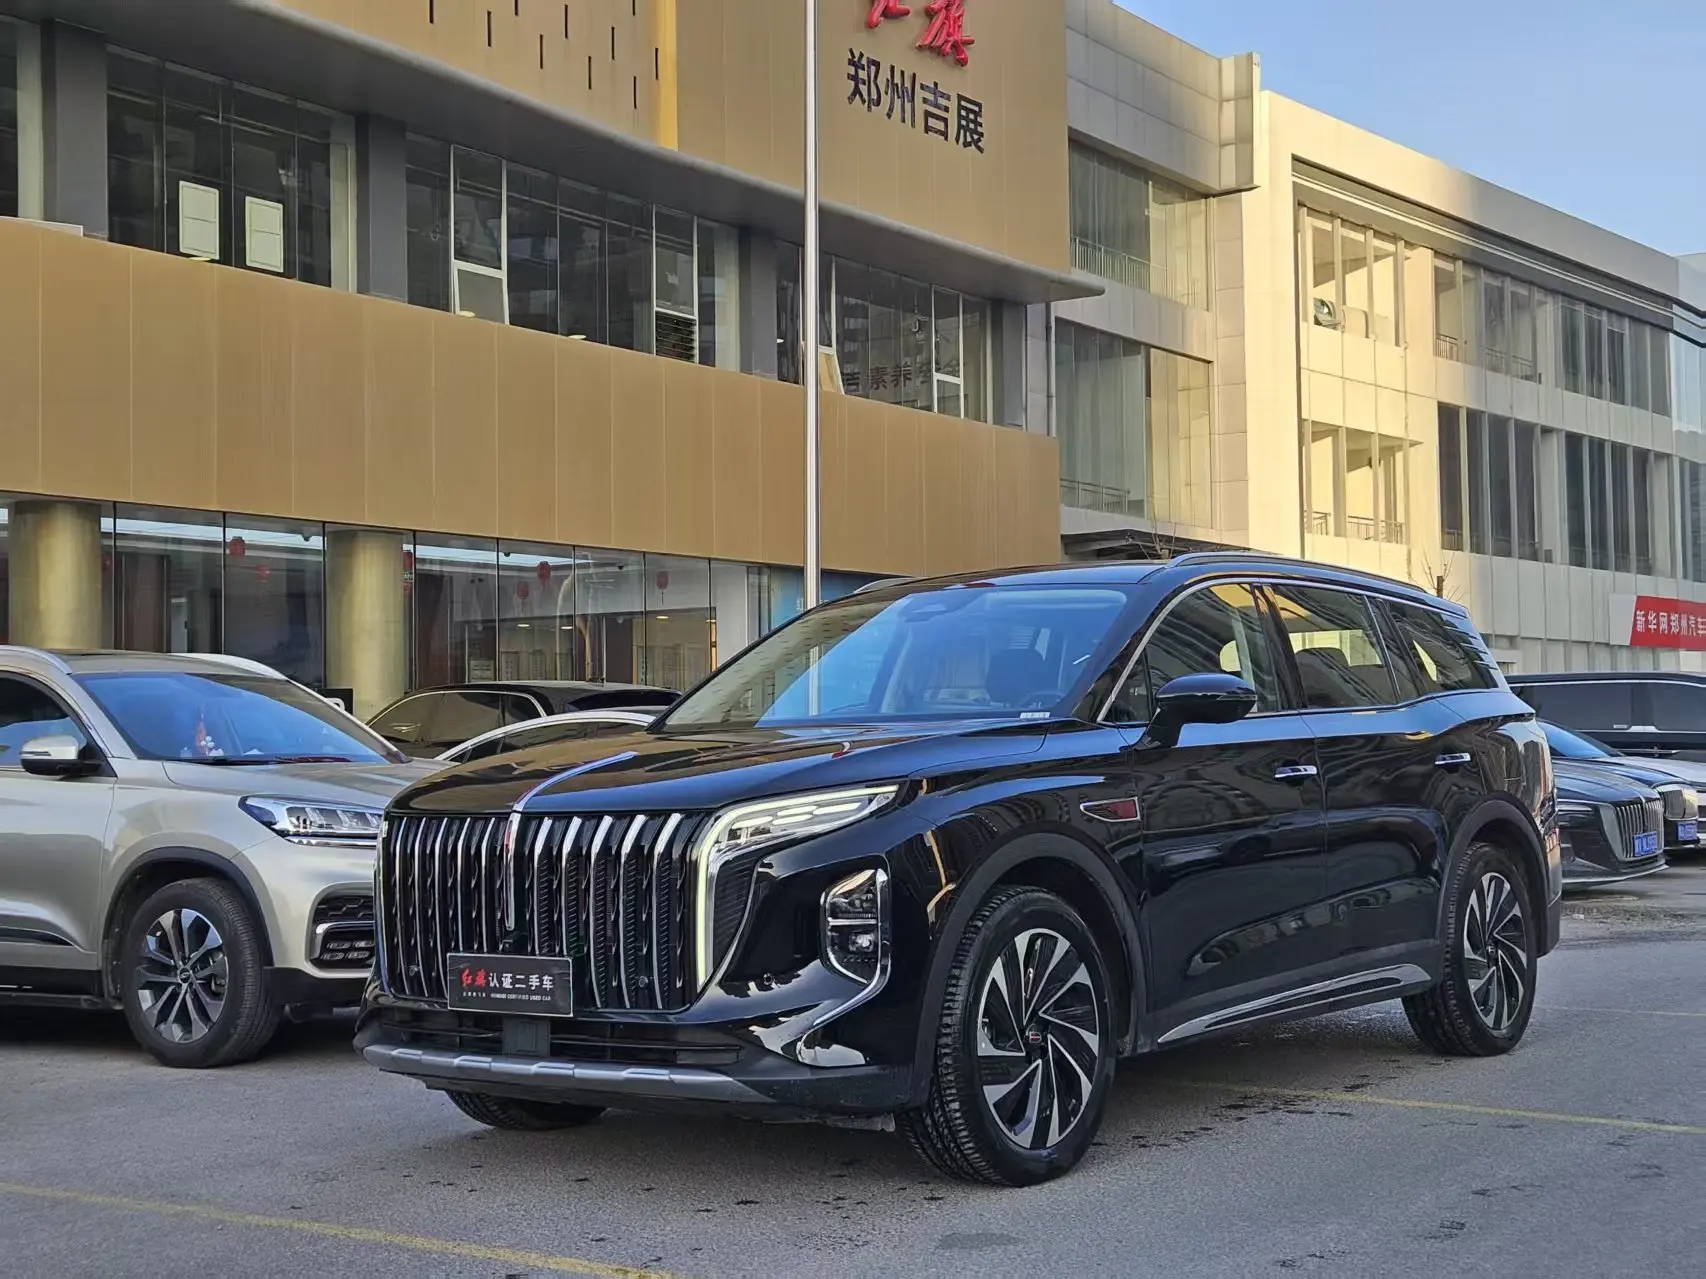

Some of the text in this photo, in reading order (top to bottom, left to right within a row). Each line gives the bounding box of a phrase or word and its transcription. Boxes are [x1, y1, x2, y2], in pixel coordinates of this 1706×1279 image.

[846, 47, 985, 154] 郑州吉展
[1636, 609, 1706, 637] 新华网郑州汽车
